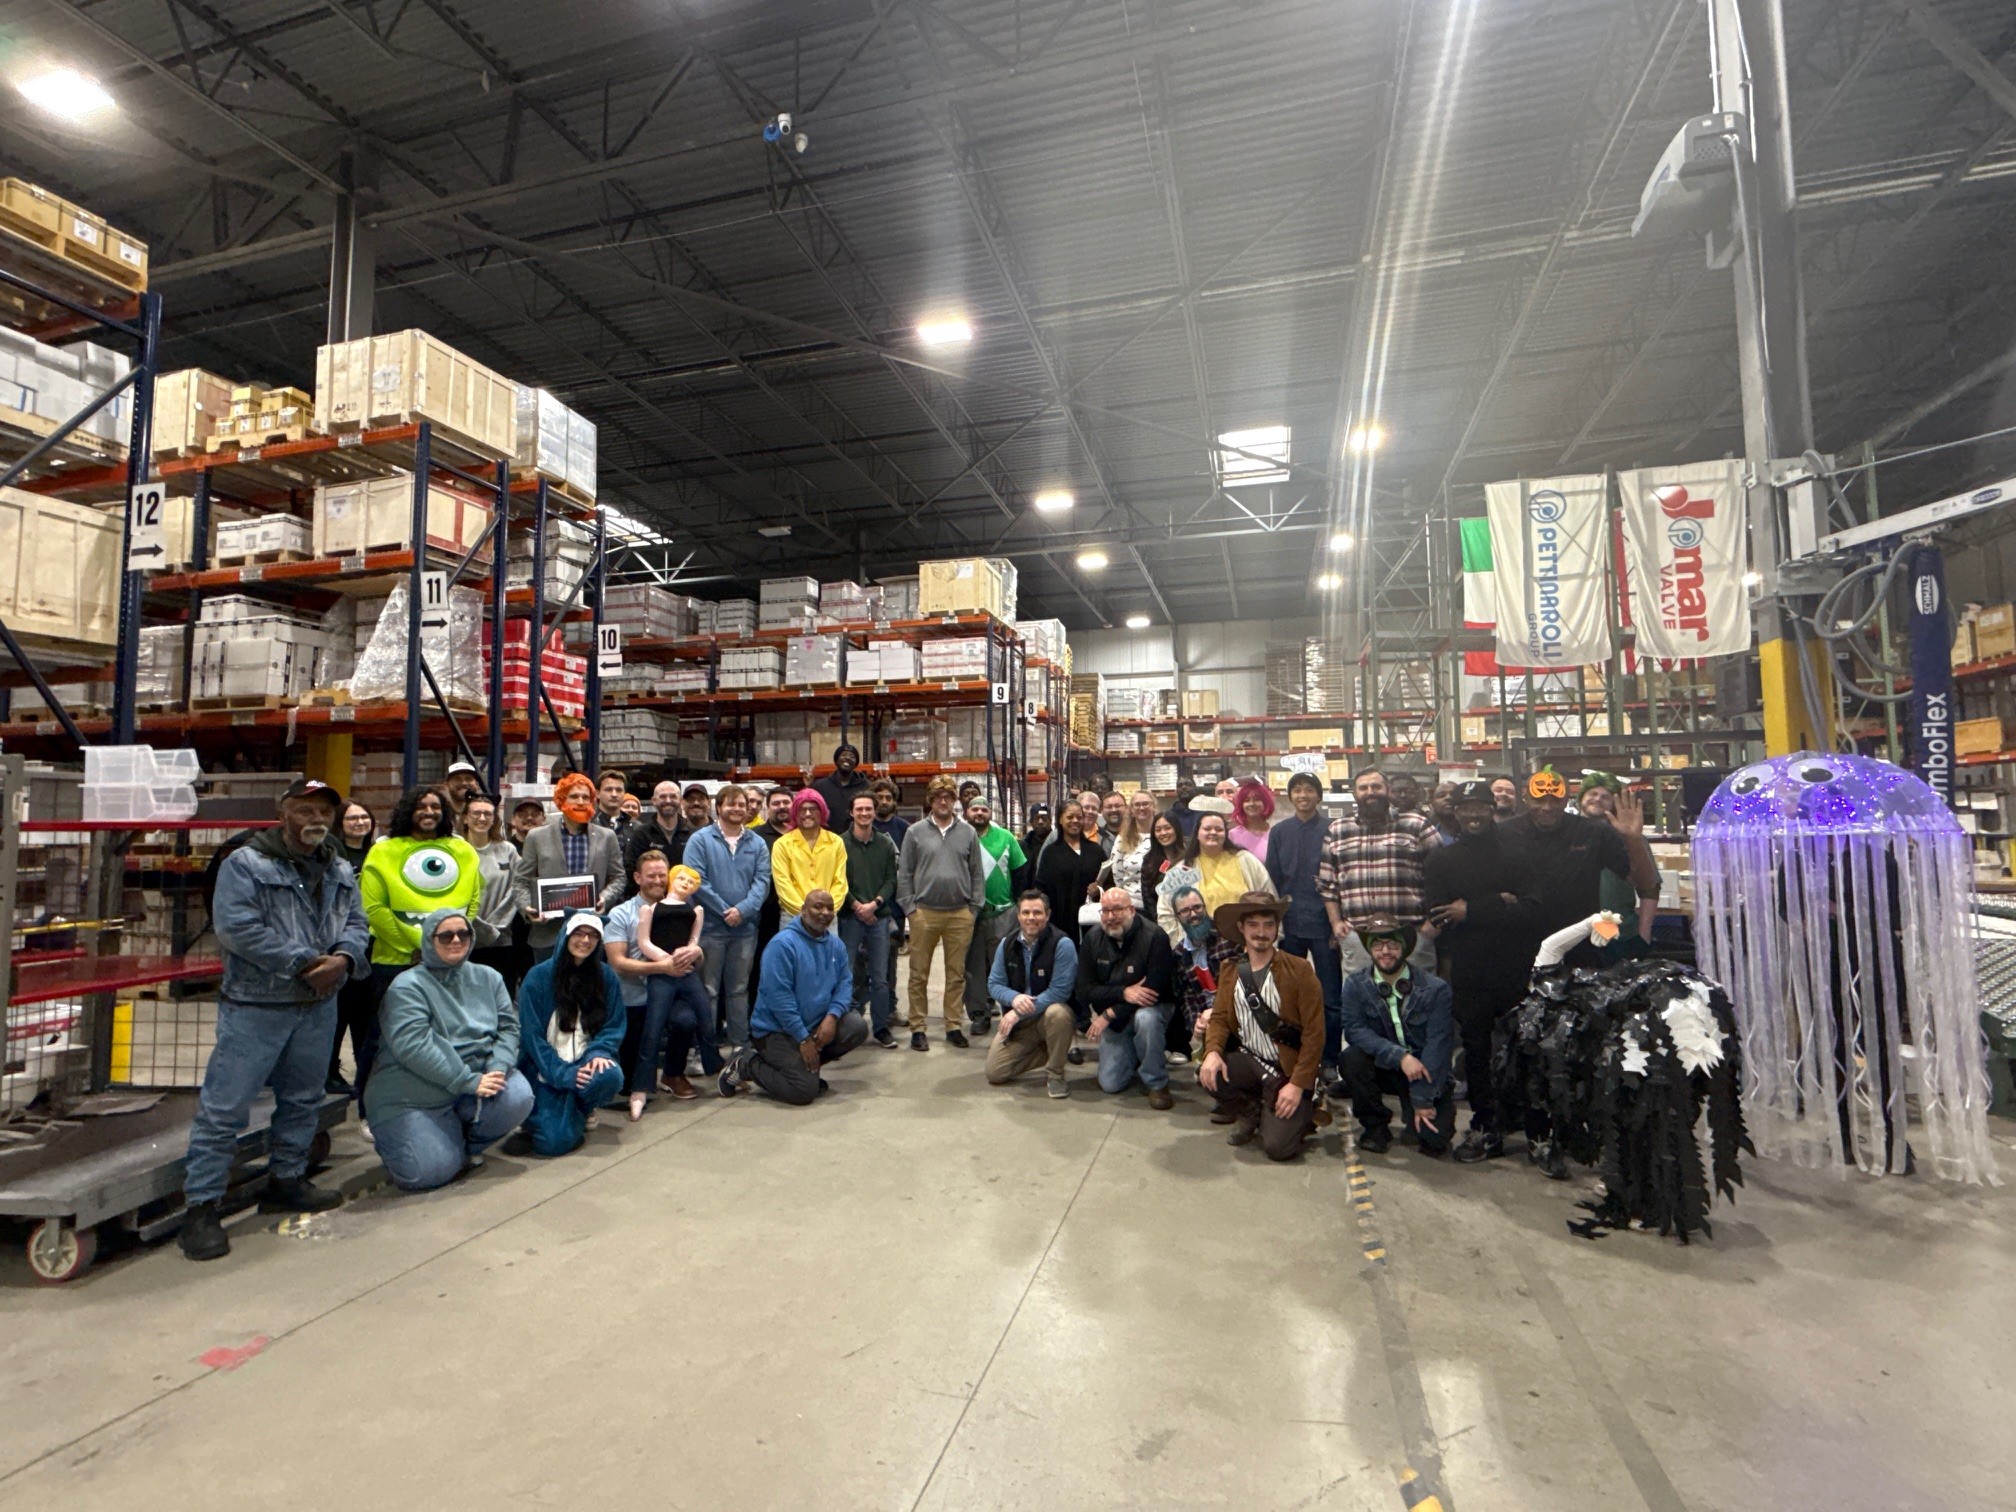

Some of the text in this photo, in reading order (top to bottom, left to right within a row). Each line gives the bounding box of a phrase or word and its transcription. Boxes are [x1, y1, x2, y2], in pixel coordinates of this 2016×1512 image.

[136, 491, 160, 527] 12
[426, 577, 441, 604] 11
[1537, 527, 1563, 658] PETTINAROLI
[1660, 564, 1677, 630] VALVE
[1923, 574, 1933, 615] SCHMALZ
[600, 629, 617, 650] 10
[1528, 612, 1540, 658] GROUP
[996, 686, 1005, 700] 9
[1028, 702, 1034, 715] 8
